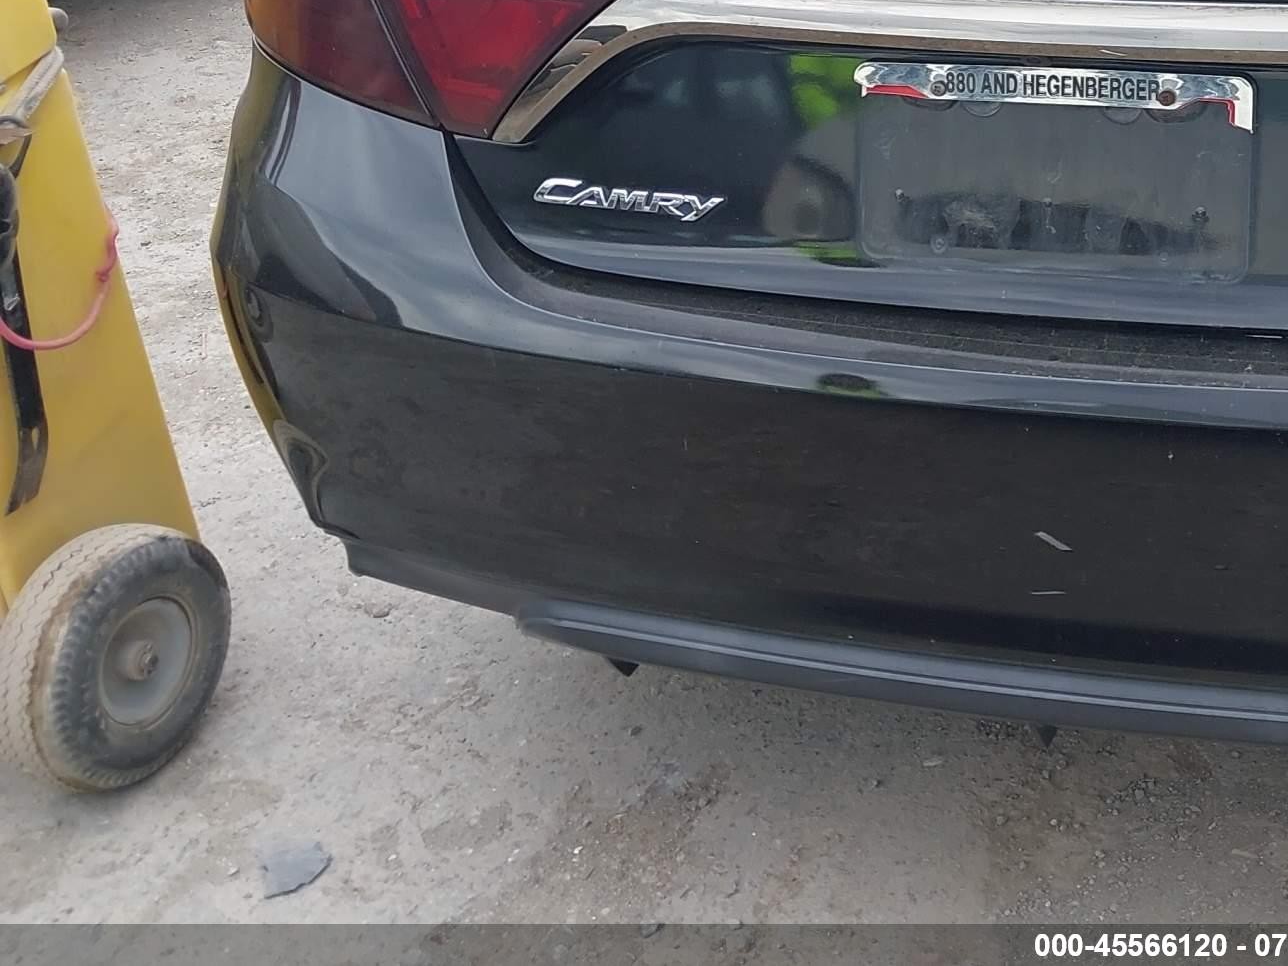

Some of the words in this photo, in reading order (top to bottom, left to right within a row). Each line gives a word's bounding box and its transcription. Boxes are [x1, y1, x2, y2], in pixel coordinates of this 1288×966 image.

[945, 72, 976, 94] 880
[981, 73, 1018, 95] AND
[1022, 73, 1160, 101] HEGENBERGER
[533, 177, 726, 222] CAMRY
